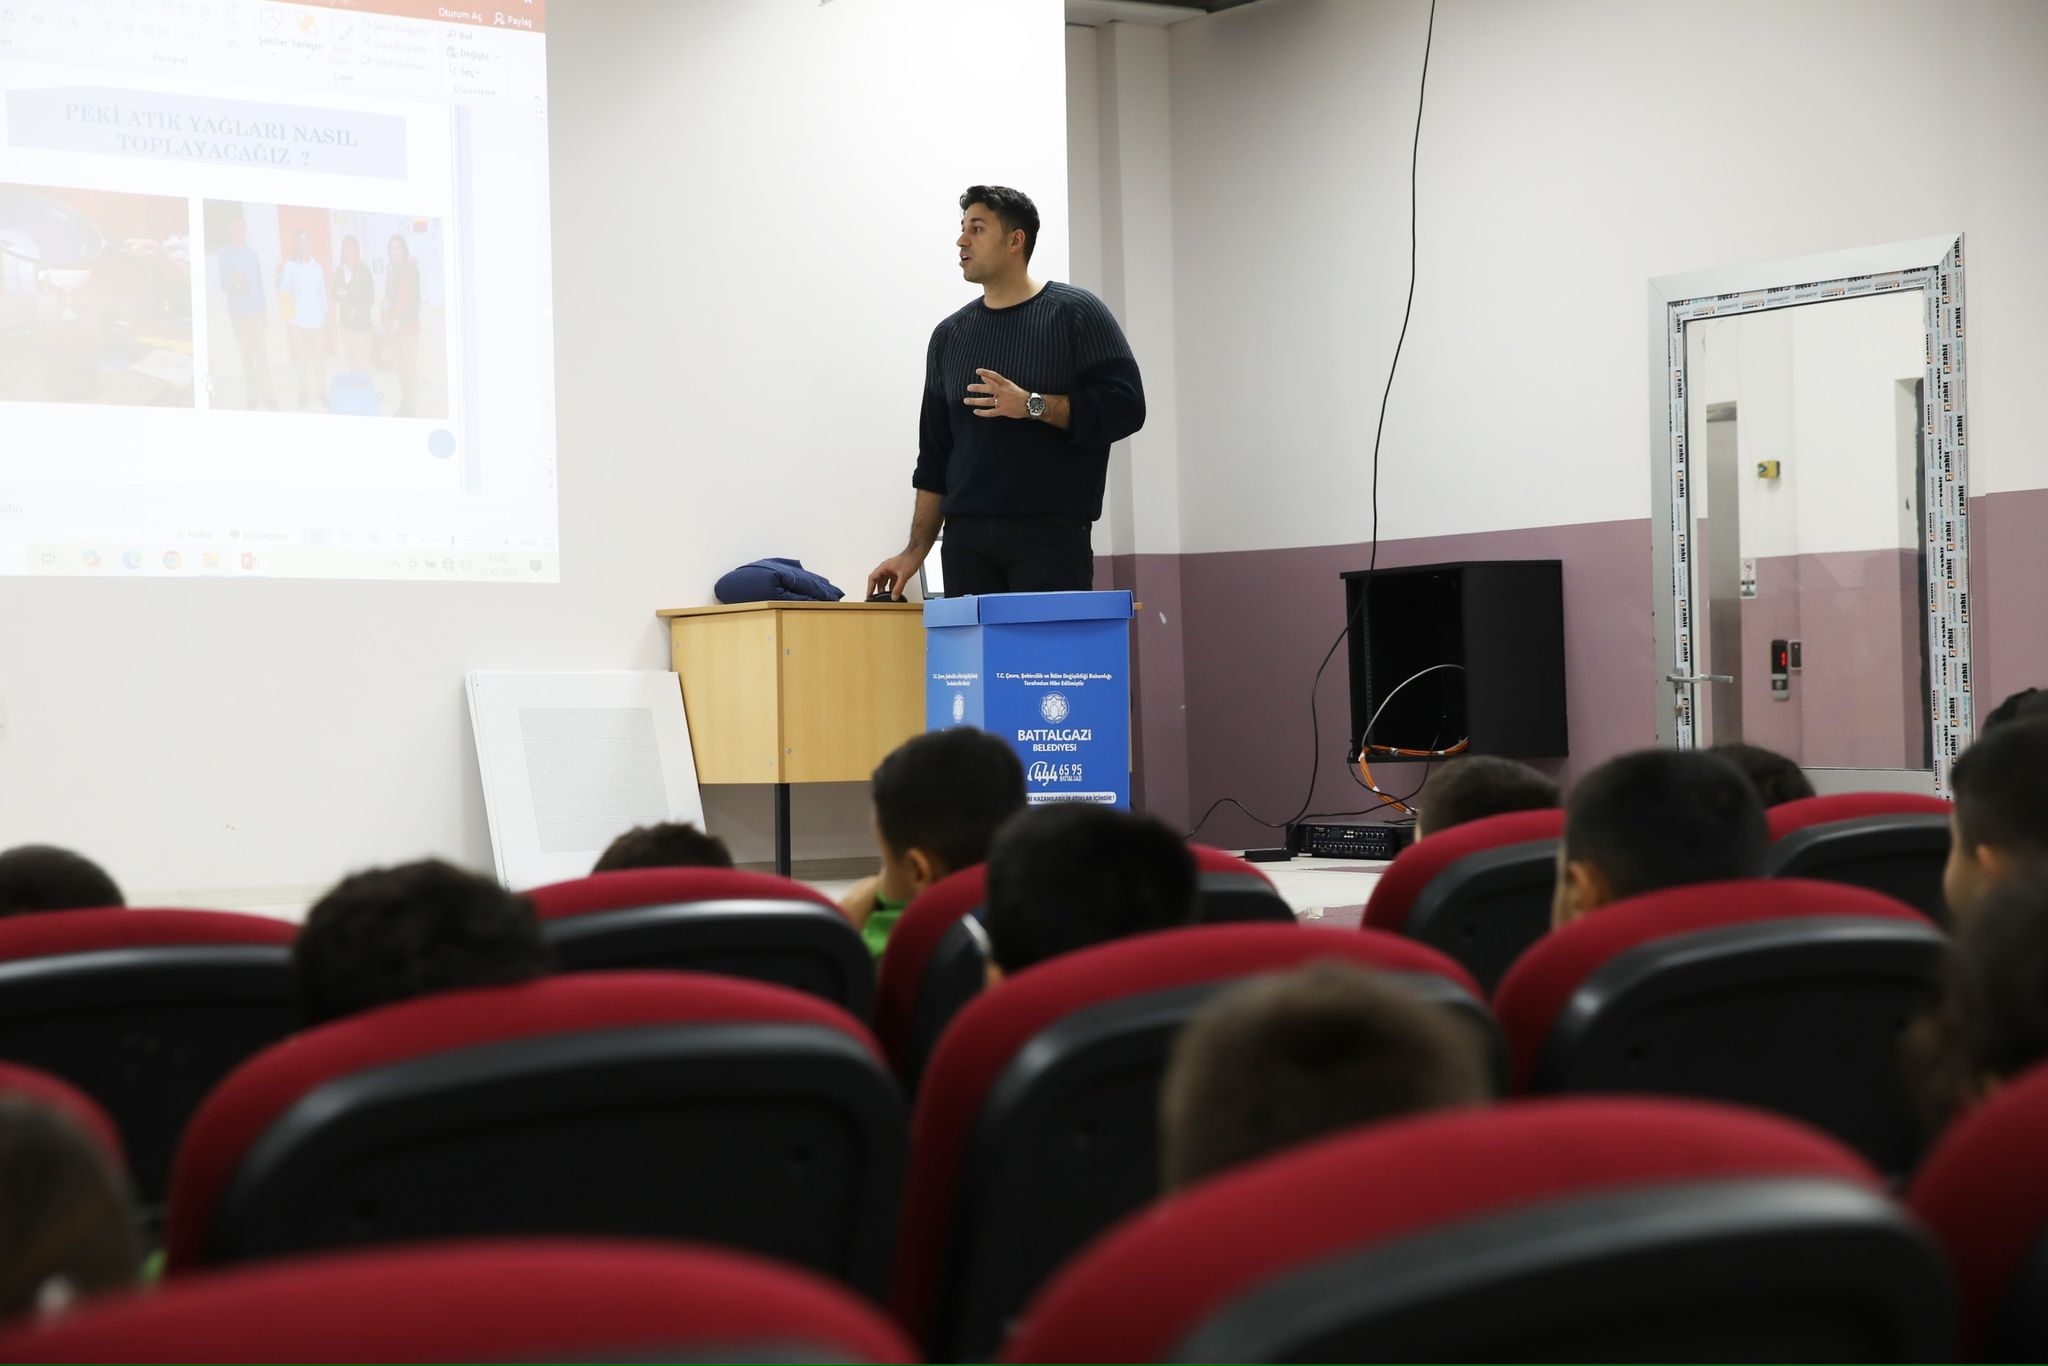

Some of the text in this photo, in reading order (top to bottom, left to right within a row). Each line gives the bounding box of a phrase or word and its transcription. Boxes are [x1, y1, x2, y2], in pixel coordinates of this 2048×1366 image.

[438, 7, 471, 19] Oturum
[507, 15, 533, 28] Paylaş
[459, 31, 473, 40] Bul
[65, 103, 358, 147] PEKİ ATIK YAĞLARI NASIL
[116, 133, 311, 166] TOPLAYACAĞIZ ?
[1059, 764, 1070, 776] 65
[1072, 764, 1082, 776] 95
